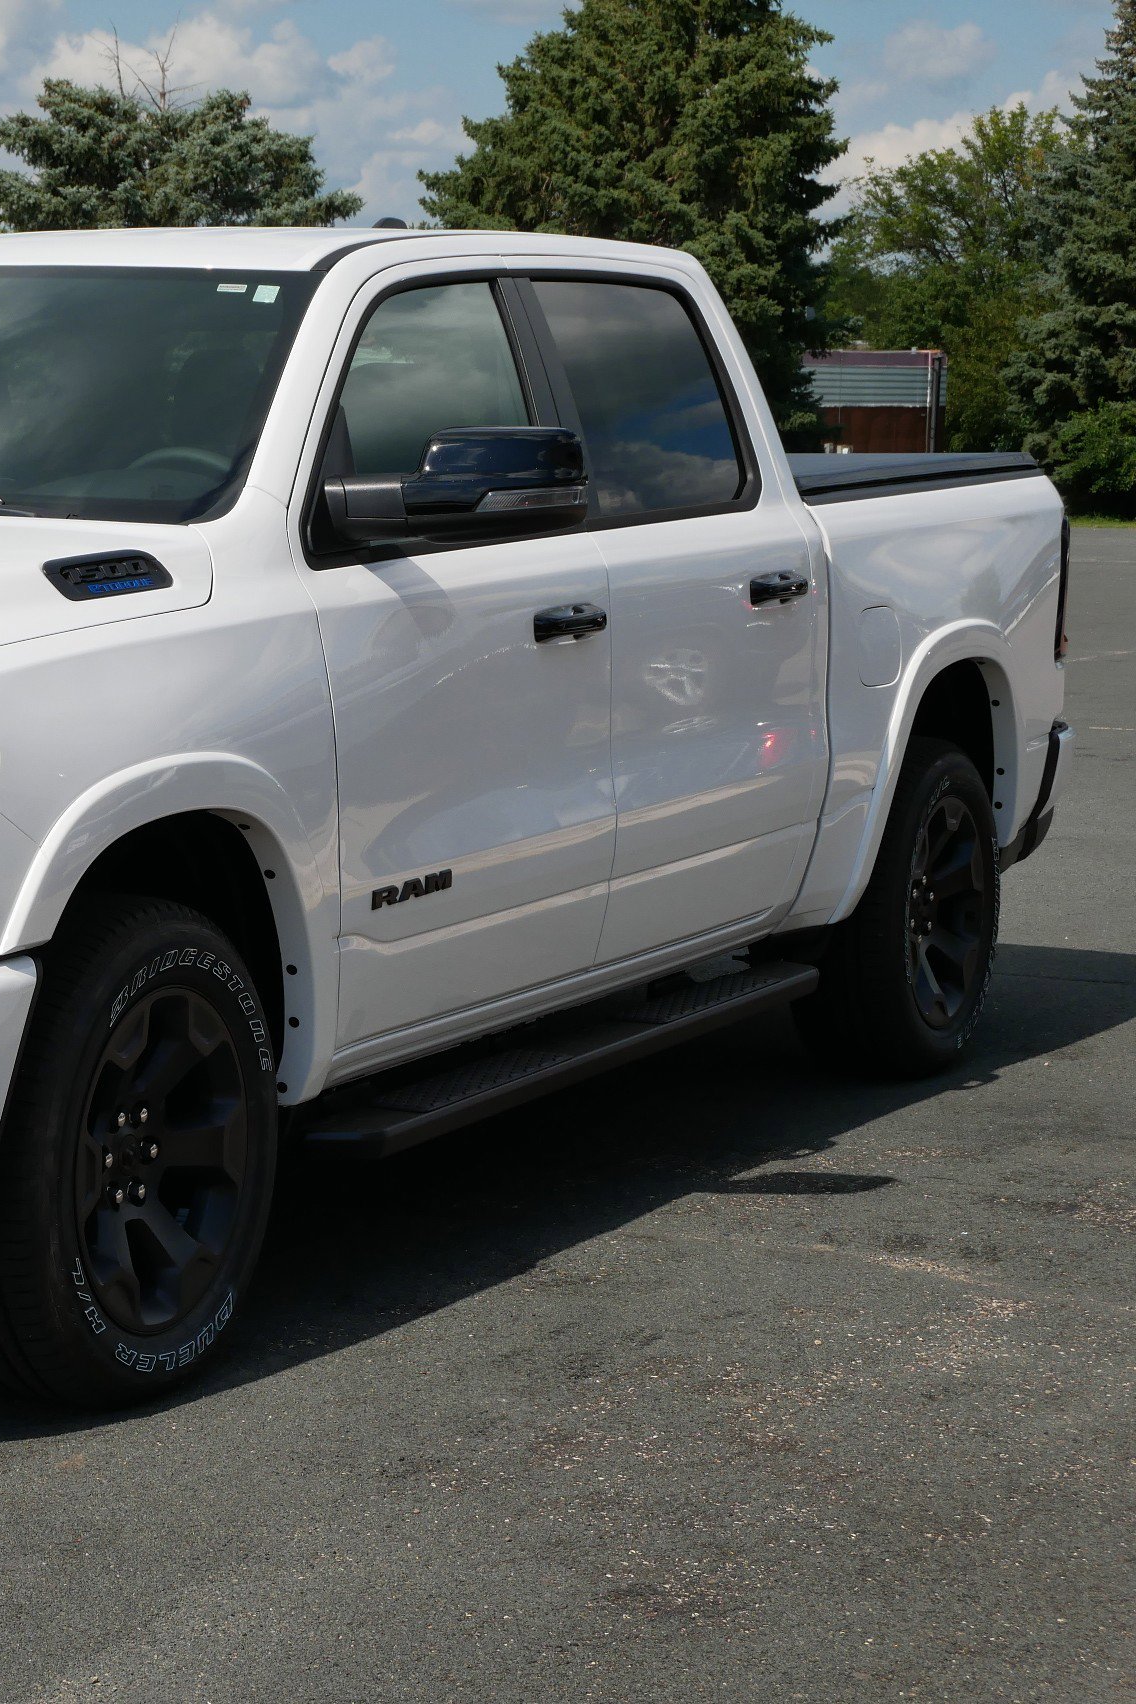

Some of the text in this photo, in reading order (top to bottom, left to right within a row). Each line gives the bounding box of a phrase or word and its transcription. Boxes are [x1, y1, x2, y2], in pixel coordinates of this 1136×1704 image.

[60, 559, 149, 585] 1500
[371, 868, 453, 911] RAM
[109, 948, 273, 1072] BRIDGESTONE
[114, 1290, 234, 1373] DUELER
